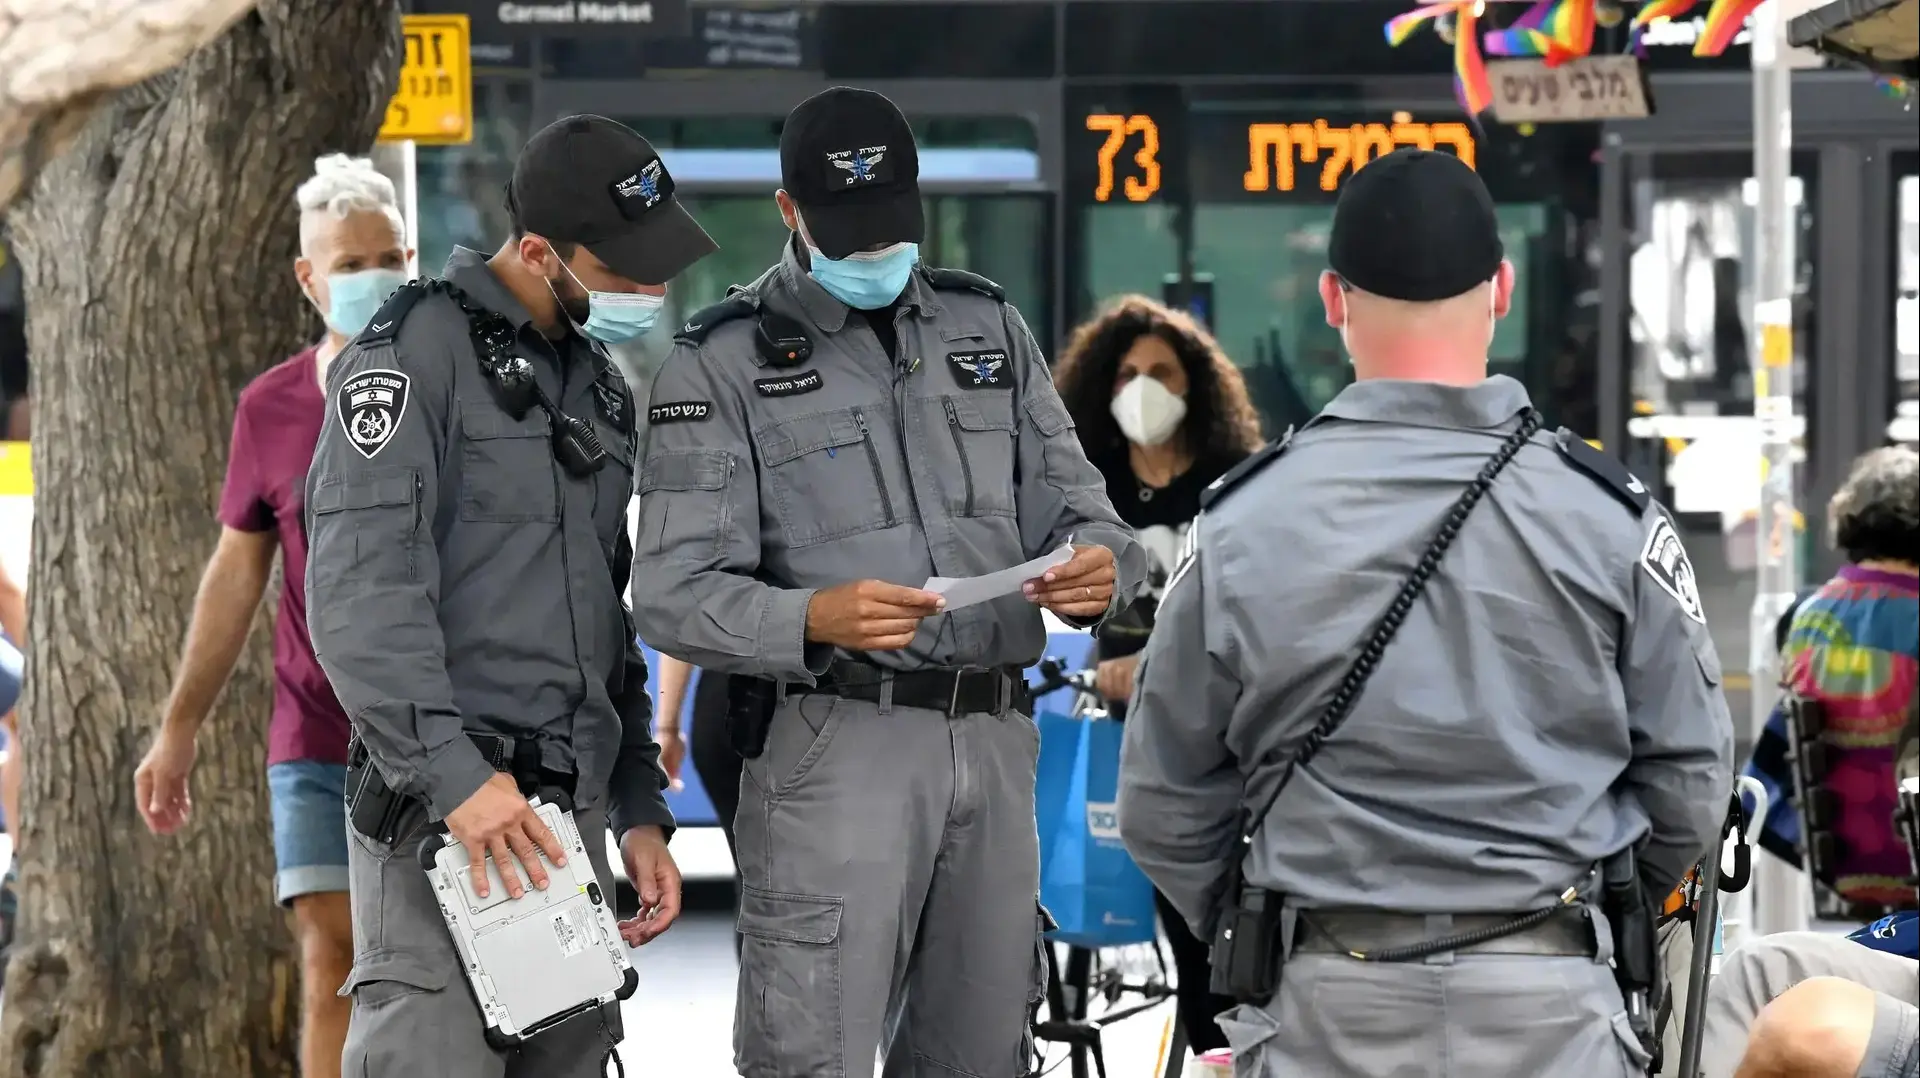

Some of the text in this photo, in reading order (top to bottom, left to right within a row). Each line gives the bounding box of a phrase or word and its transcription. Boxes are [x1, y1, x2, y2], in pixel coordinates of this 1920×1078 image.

[498, 2, 653, 23] Carmel Market
[826, 145, 887, 161] משטרת ישראל
[1086, 114, 1161, 201] 73
[615, 174, 637, 190] ישראל
[951, 354, 974, 362] ישראל
[344, 376, 403, 394] משטרת ישראל
[793, 375, 818, 389] דניאל
[651, 404, 707, 421] משטרה
